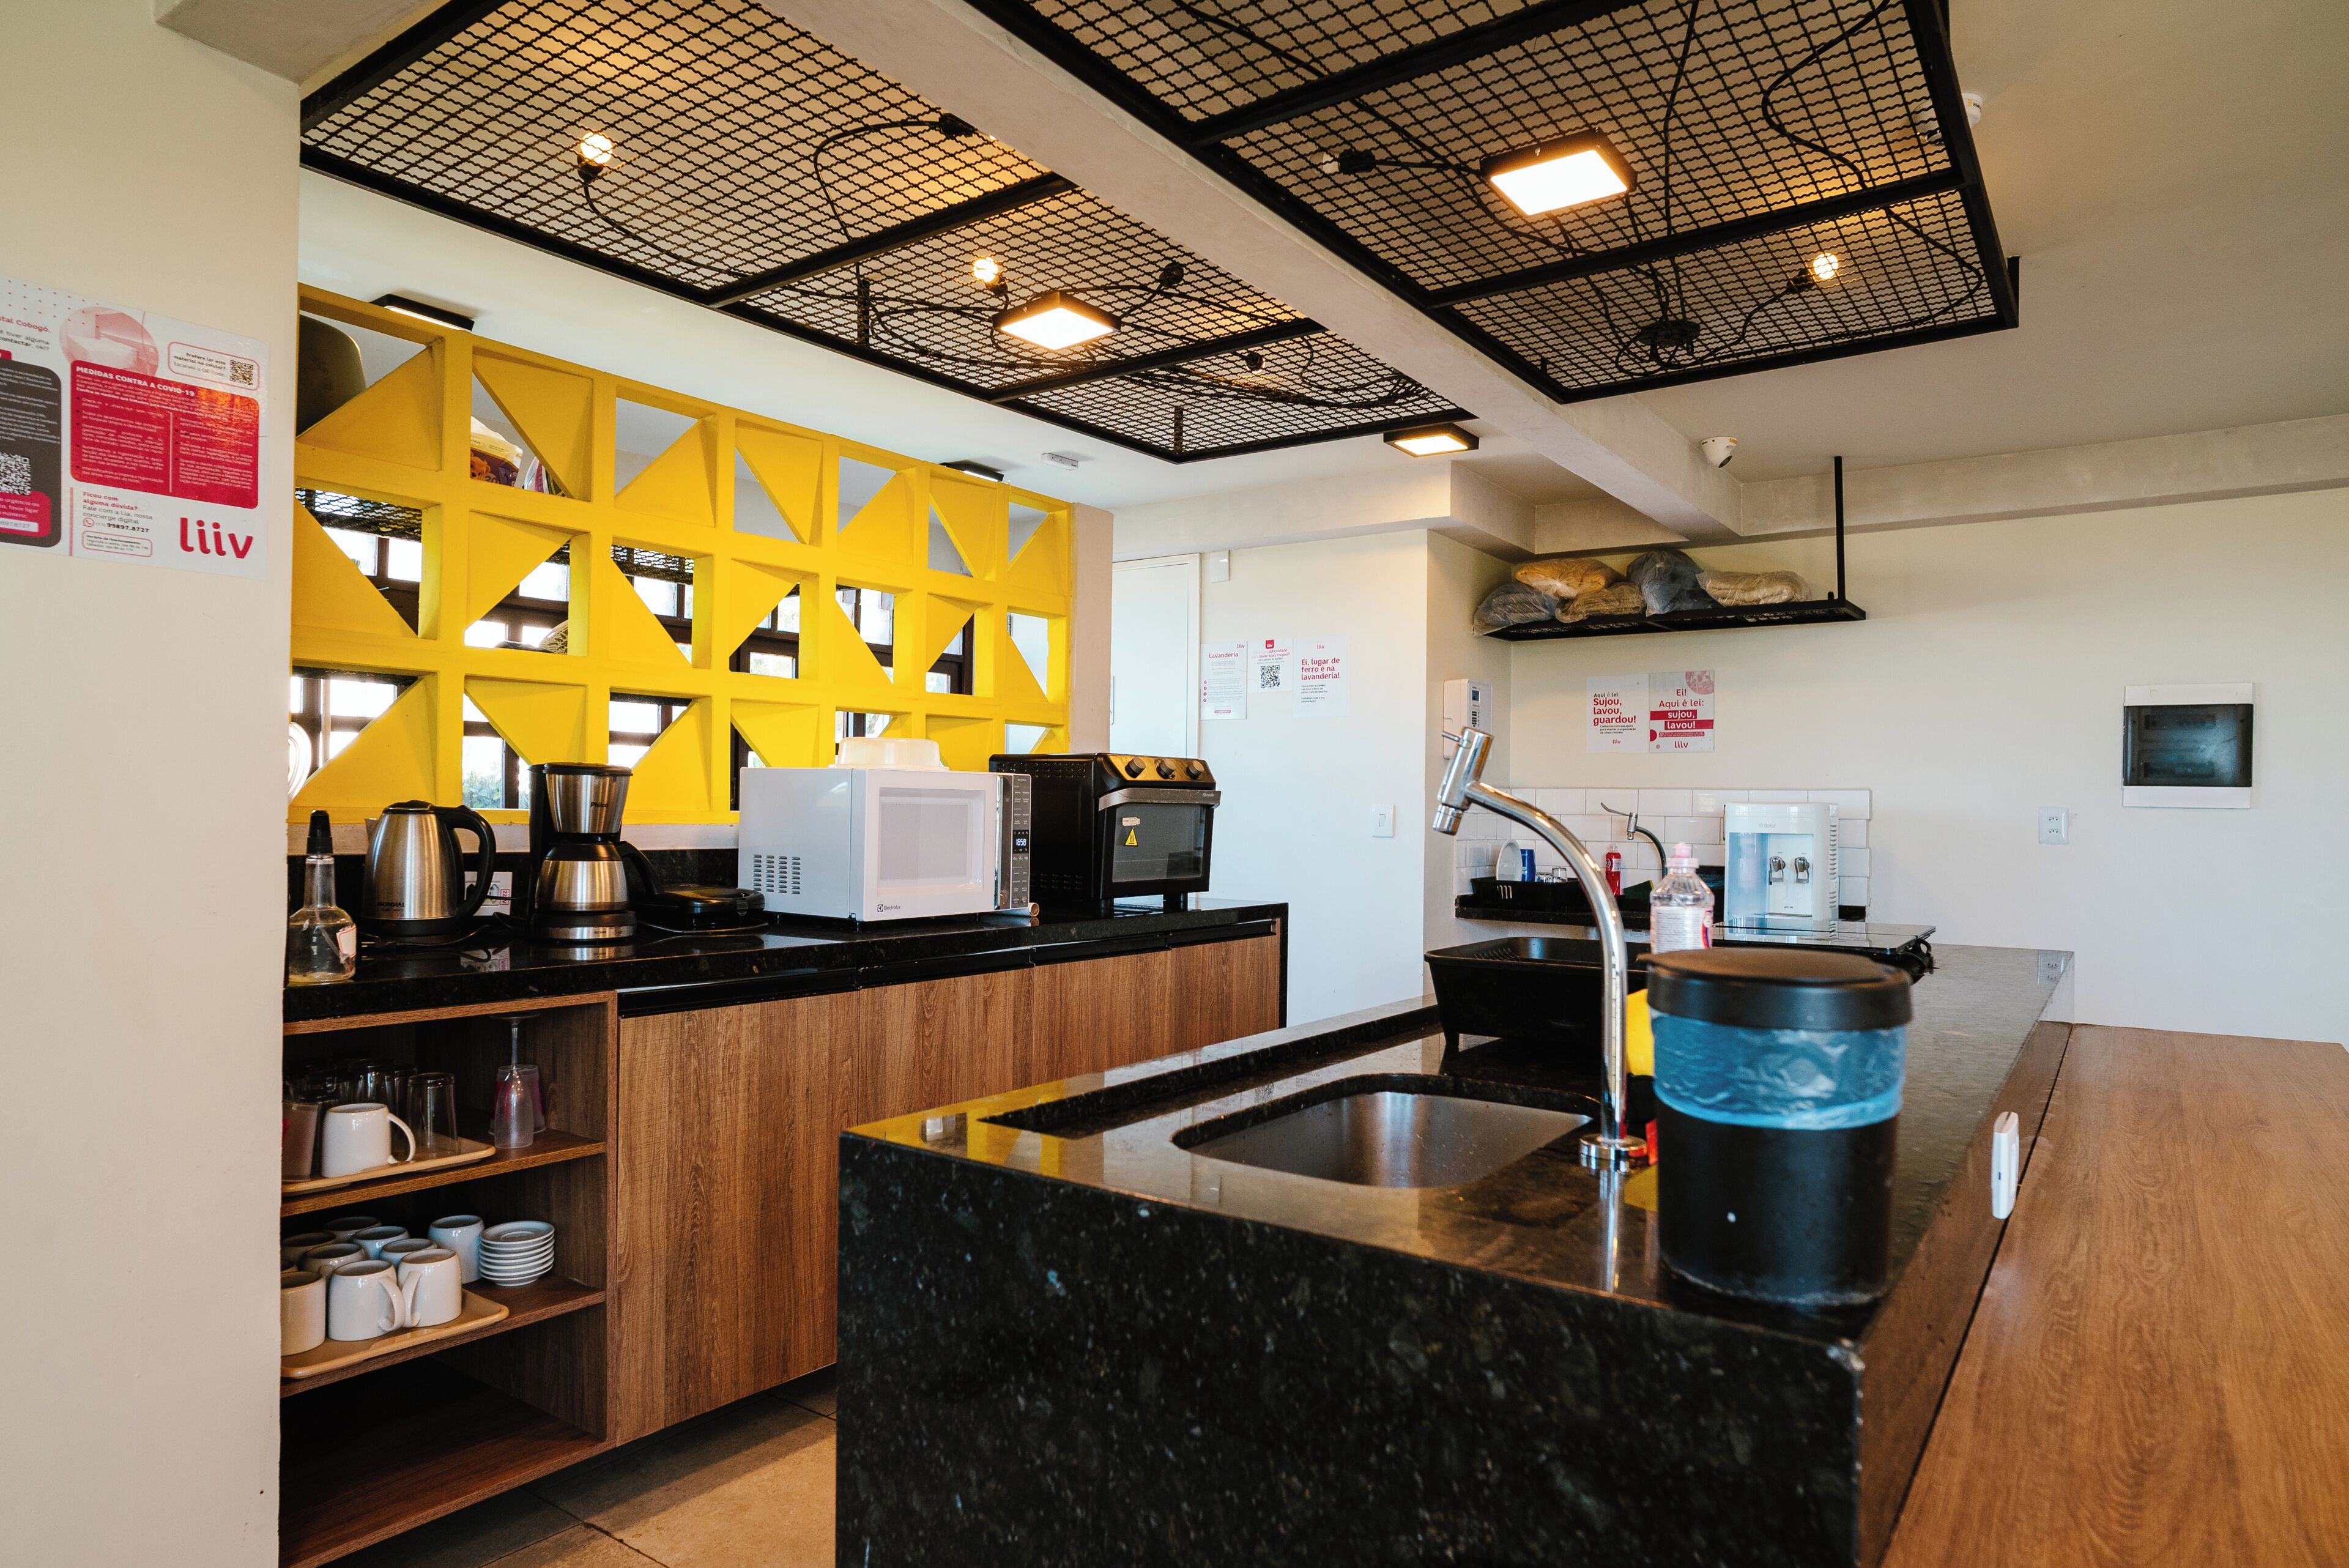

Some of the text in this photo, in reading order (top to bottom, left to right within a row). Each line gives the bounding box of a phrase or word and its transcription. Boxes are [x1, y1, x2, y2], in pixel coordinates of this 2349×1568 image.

[76, 366, 114, 379] MEDIDAS
[115, 374, 149, 387] CONTRA
[157, 384, 195, 396] COVID-19
[83, 513, 116, 521] concierge
[107, 522, 149, 533] 99897.8727
[180, 517, 254, 559] liiv
[1301, 672, 1340, 680] lavanderia!
[1594, 697, 1622, 707] Sujou,
[1659, 700, 1679, 709] Aqui
[1594, 707, 1622, 716] lavou,
[1668, 710, 1694, 719] sujou,
[1593, 715, 1636, 726] guardou!
[1667, 721, 1696, 729] lavou!
